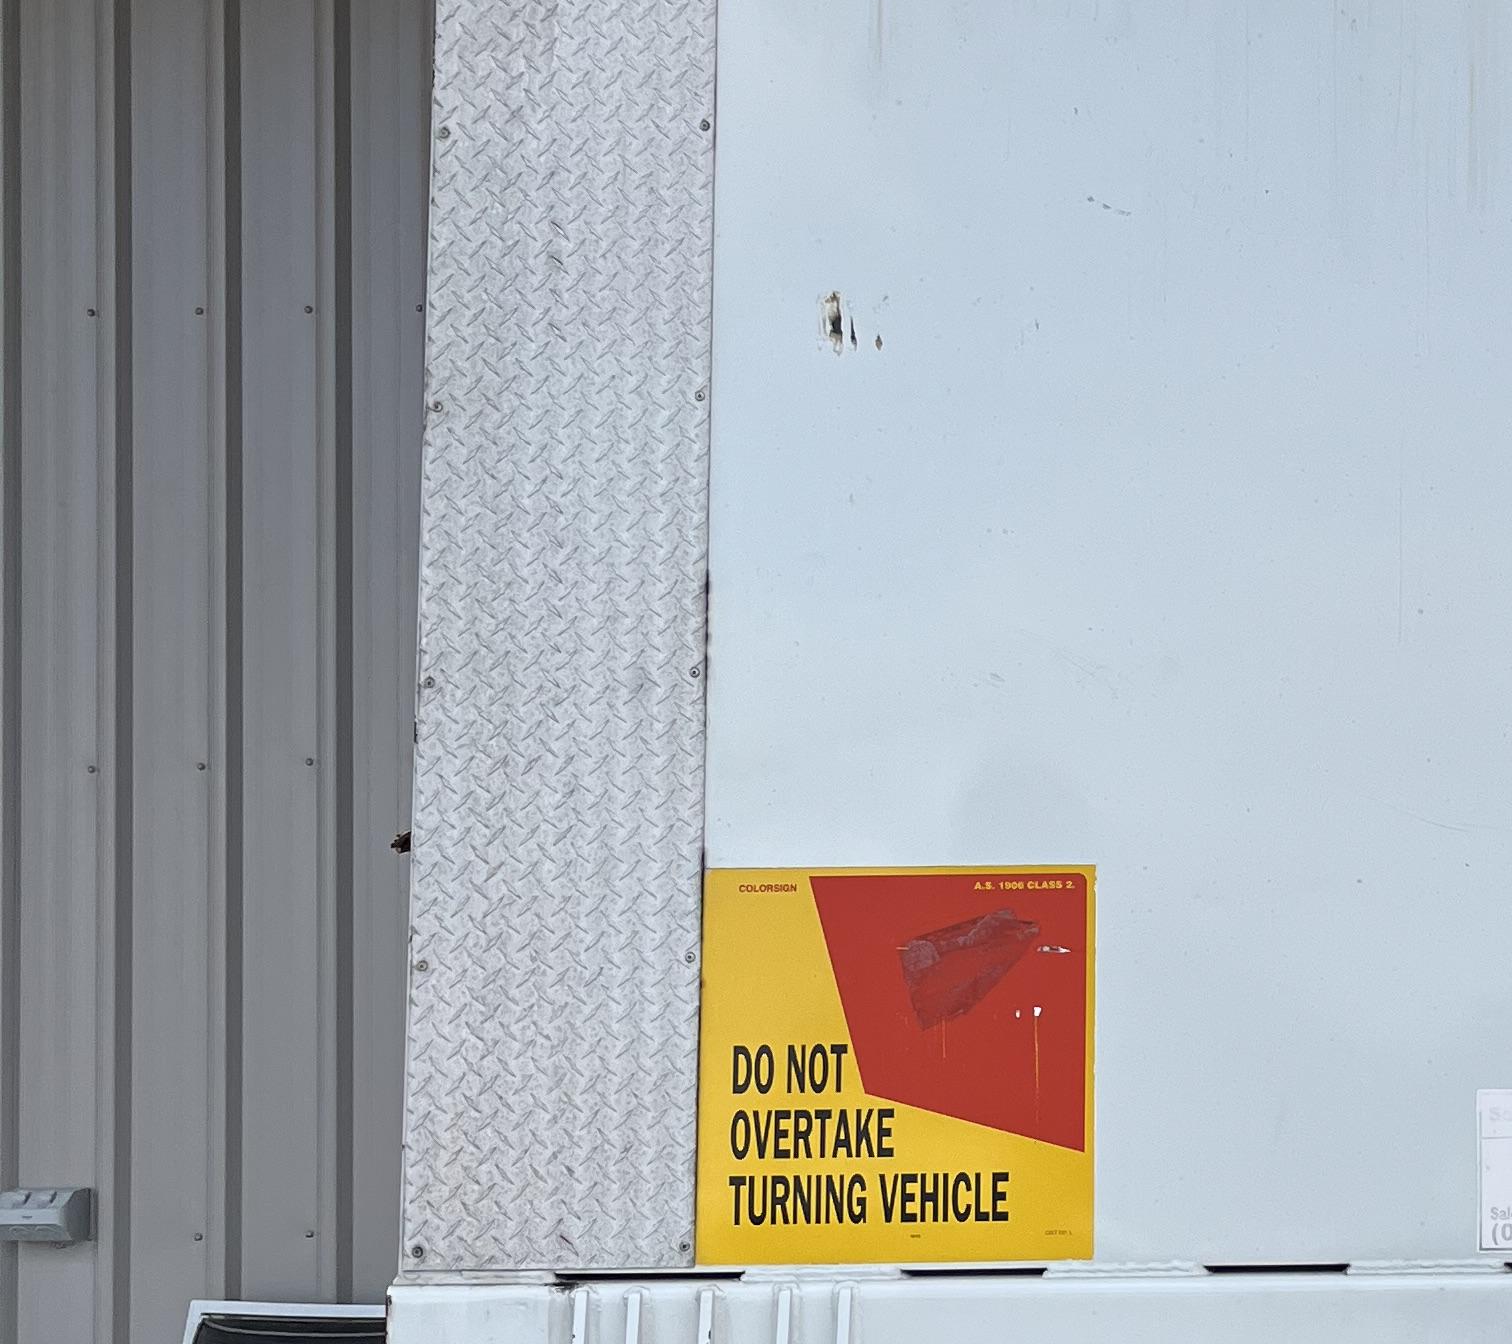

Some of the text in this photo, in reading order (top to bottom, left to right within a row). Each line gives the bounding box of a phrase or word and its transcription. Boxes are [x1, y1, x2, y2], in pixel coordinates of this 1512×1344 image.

[738, 883, 798, 893] COLORSIGN
[1026, 880, 1063, 889] CLASS
[732, 1043, 849, 1094] DO NOT
[730, 1108, 896, 1160] OVERTAKE
[729, 1171, 1010, 1226] TURNING VEHICLE
